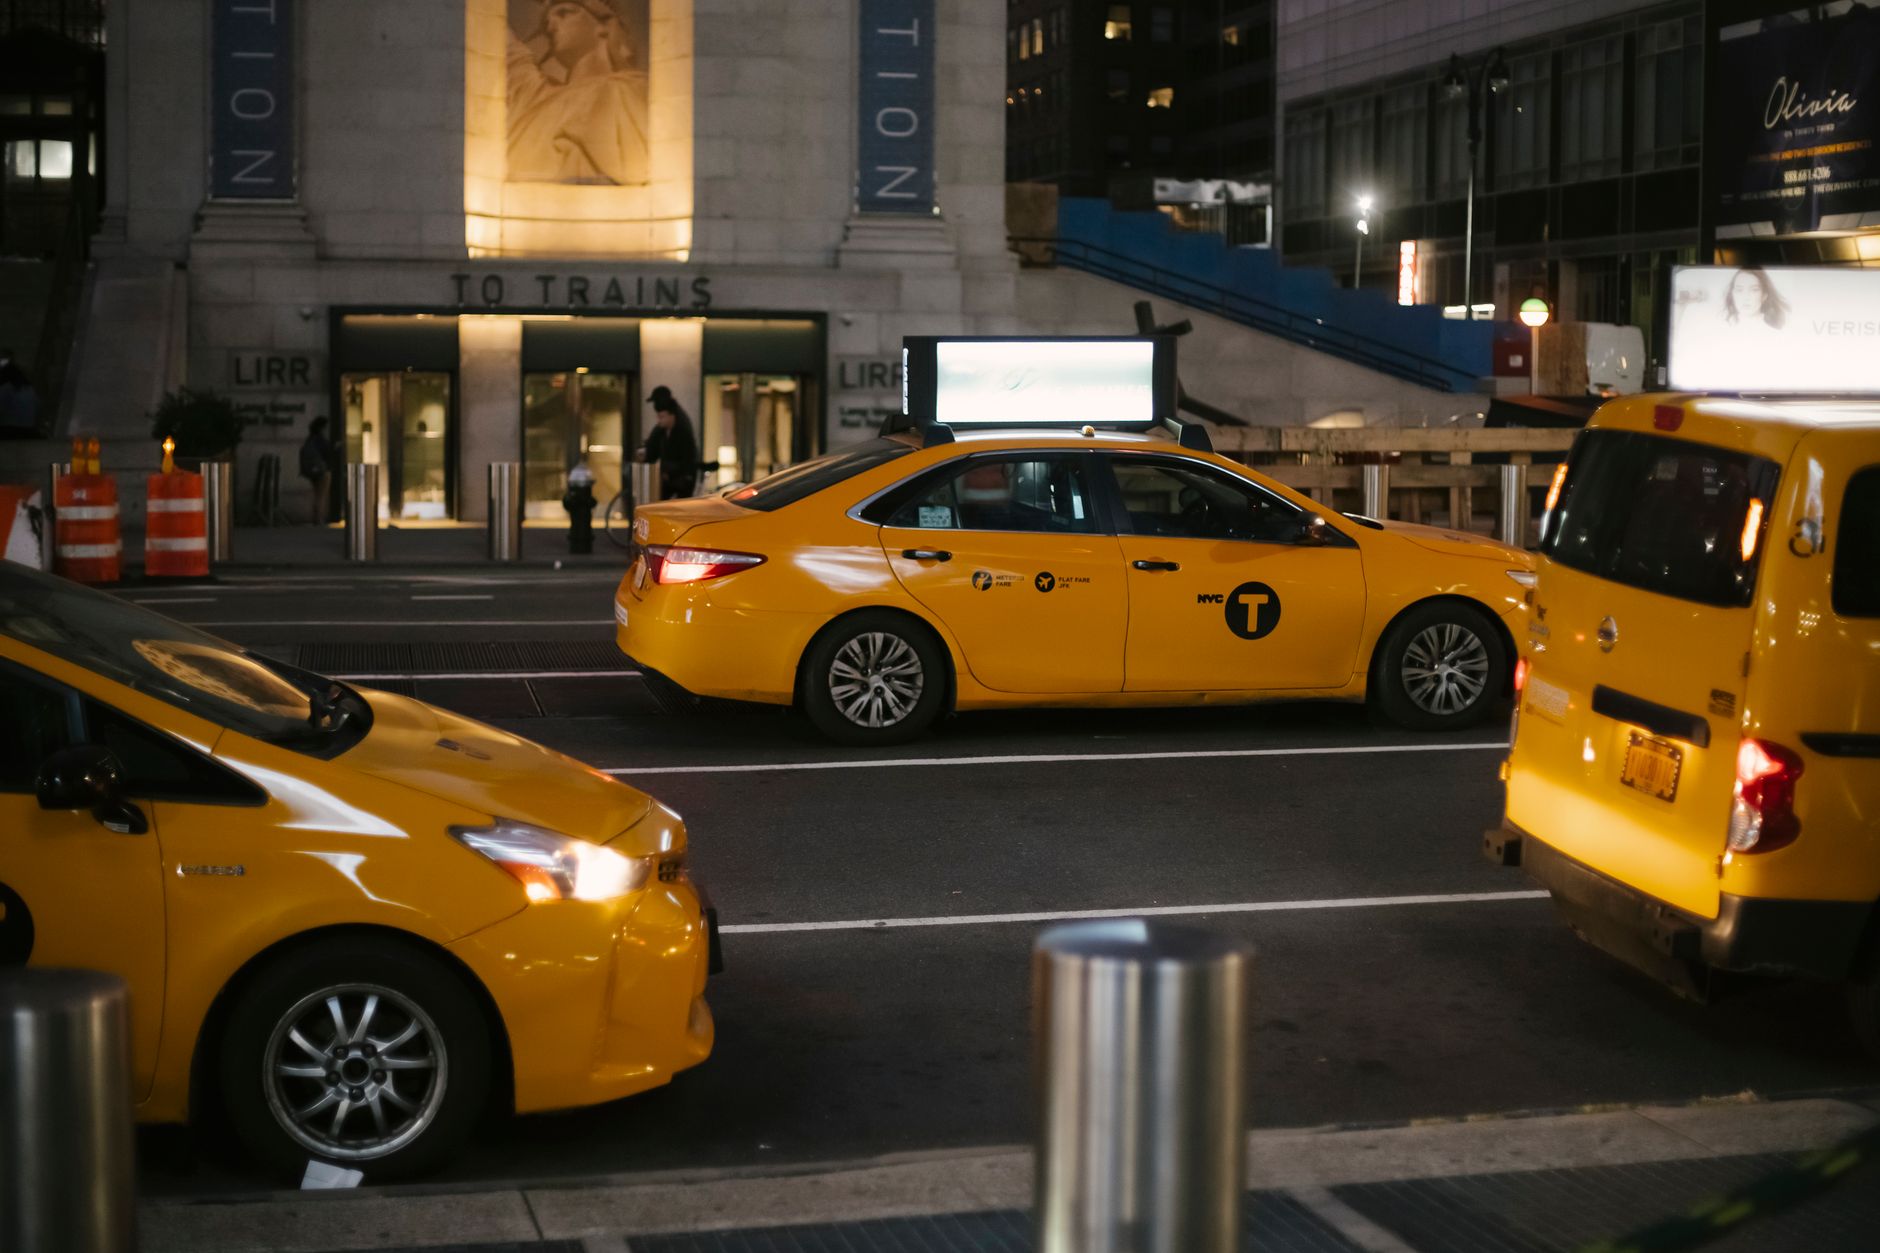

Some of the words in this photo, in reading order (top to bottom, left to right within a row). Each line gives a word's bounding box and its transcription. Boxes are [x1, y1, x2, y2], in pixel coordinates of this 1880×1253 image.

[1764, 76, 1857, 129] Olivia
[452, 274, 504, 305] TO
[536, 275, 712, 307] TRAINS
[1812, 320, 1880, 336] VERIS
[235, 357, 311, 386] LIRR
[1197, 593, 1224, 604] NYC
